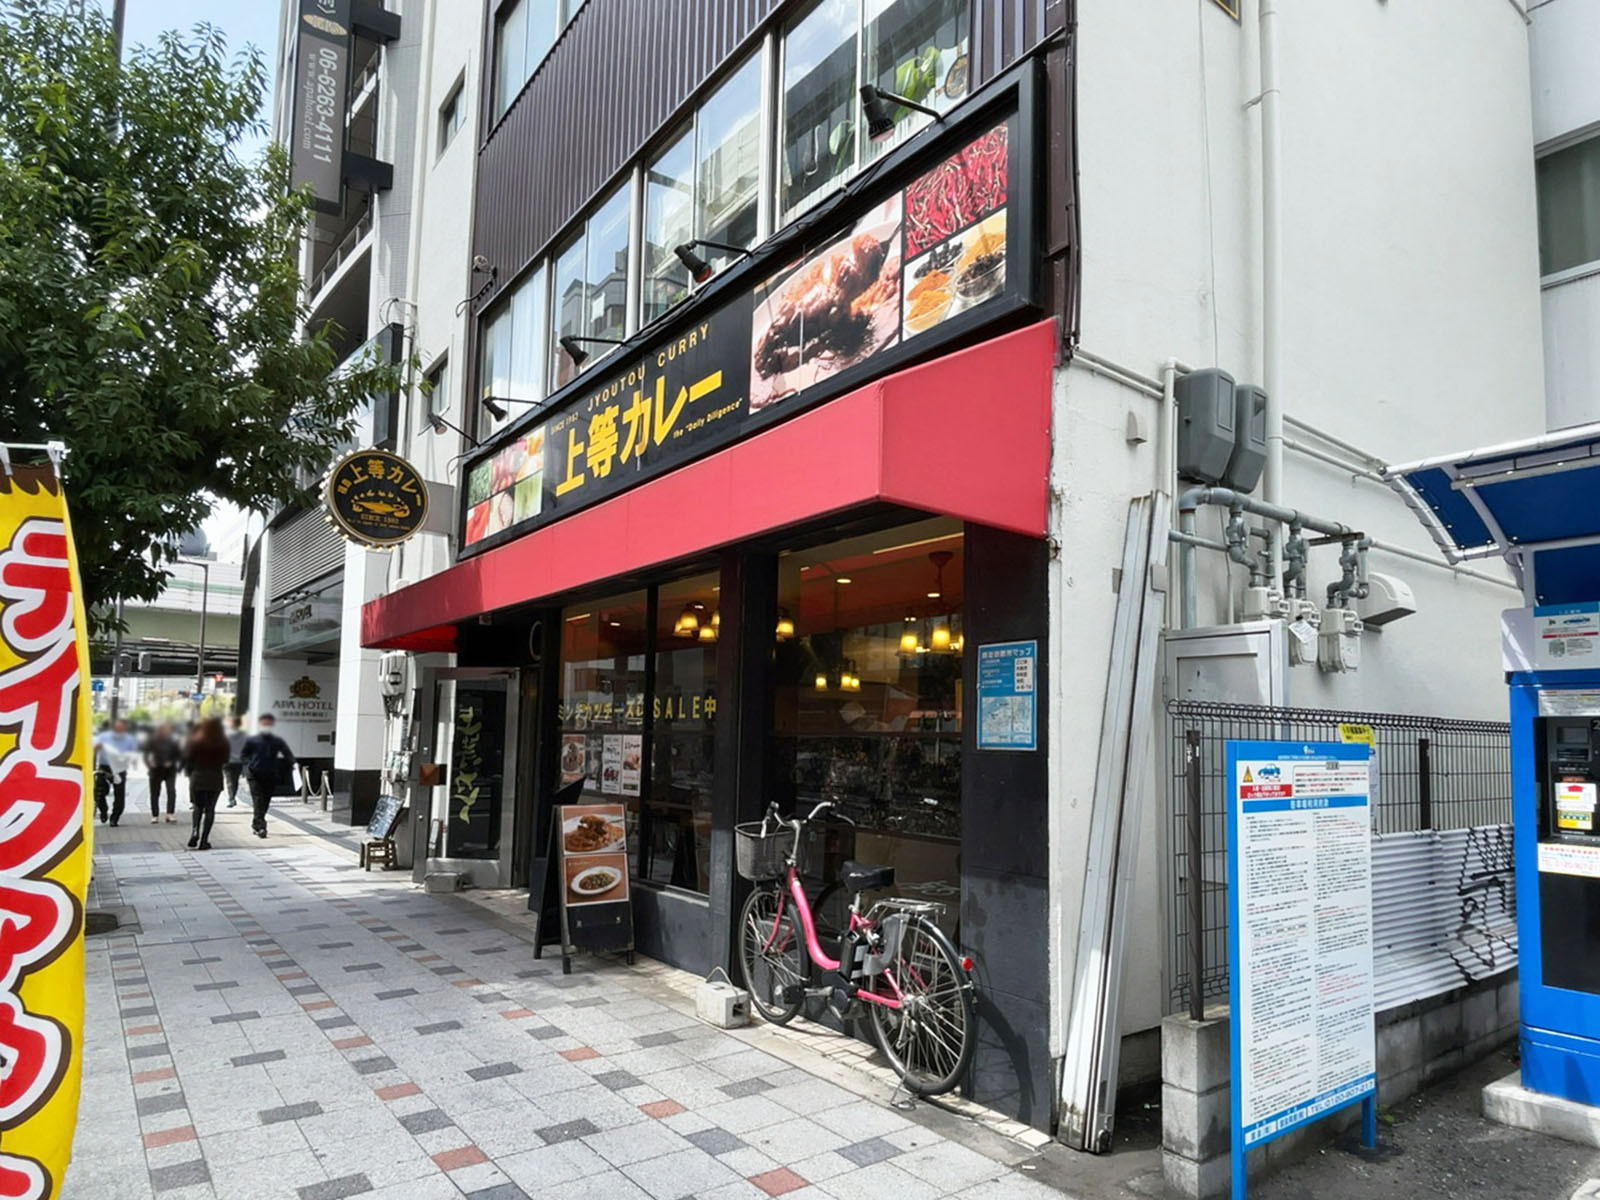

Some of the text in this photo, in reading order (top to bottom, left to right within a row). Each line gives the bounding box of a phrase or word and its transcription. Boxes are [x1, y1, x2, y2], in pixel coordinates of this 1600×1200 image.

[313, 47, 338, 164] 06-6263-4111
[587, 323, 710, 411] JYOUTOU CURRY
[556, 370, 723, 497] 上等カレー
[349, 459, 422, 507] 上等カレー
[299, 701, 334, 712] HOTEL
